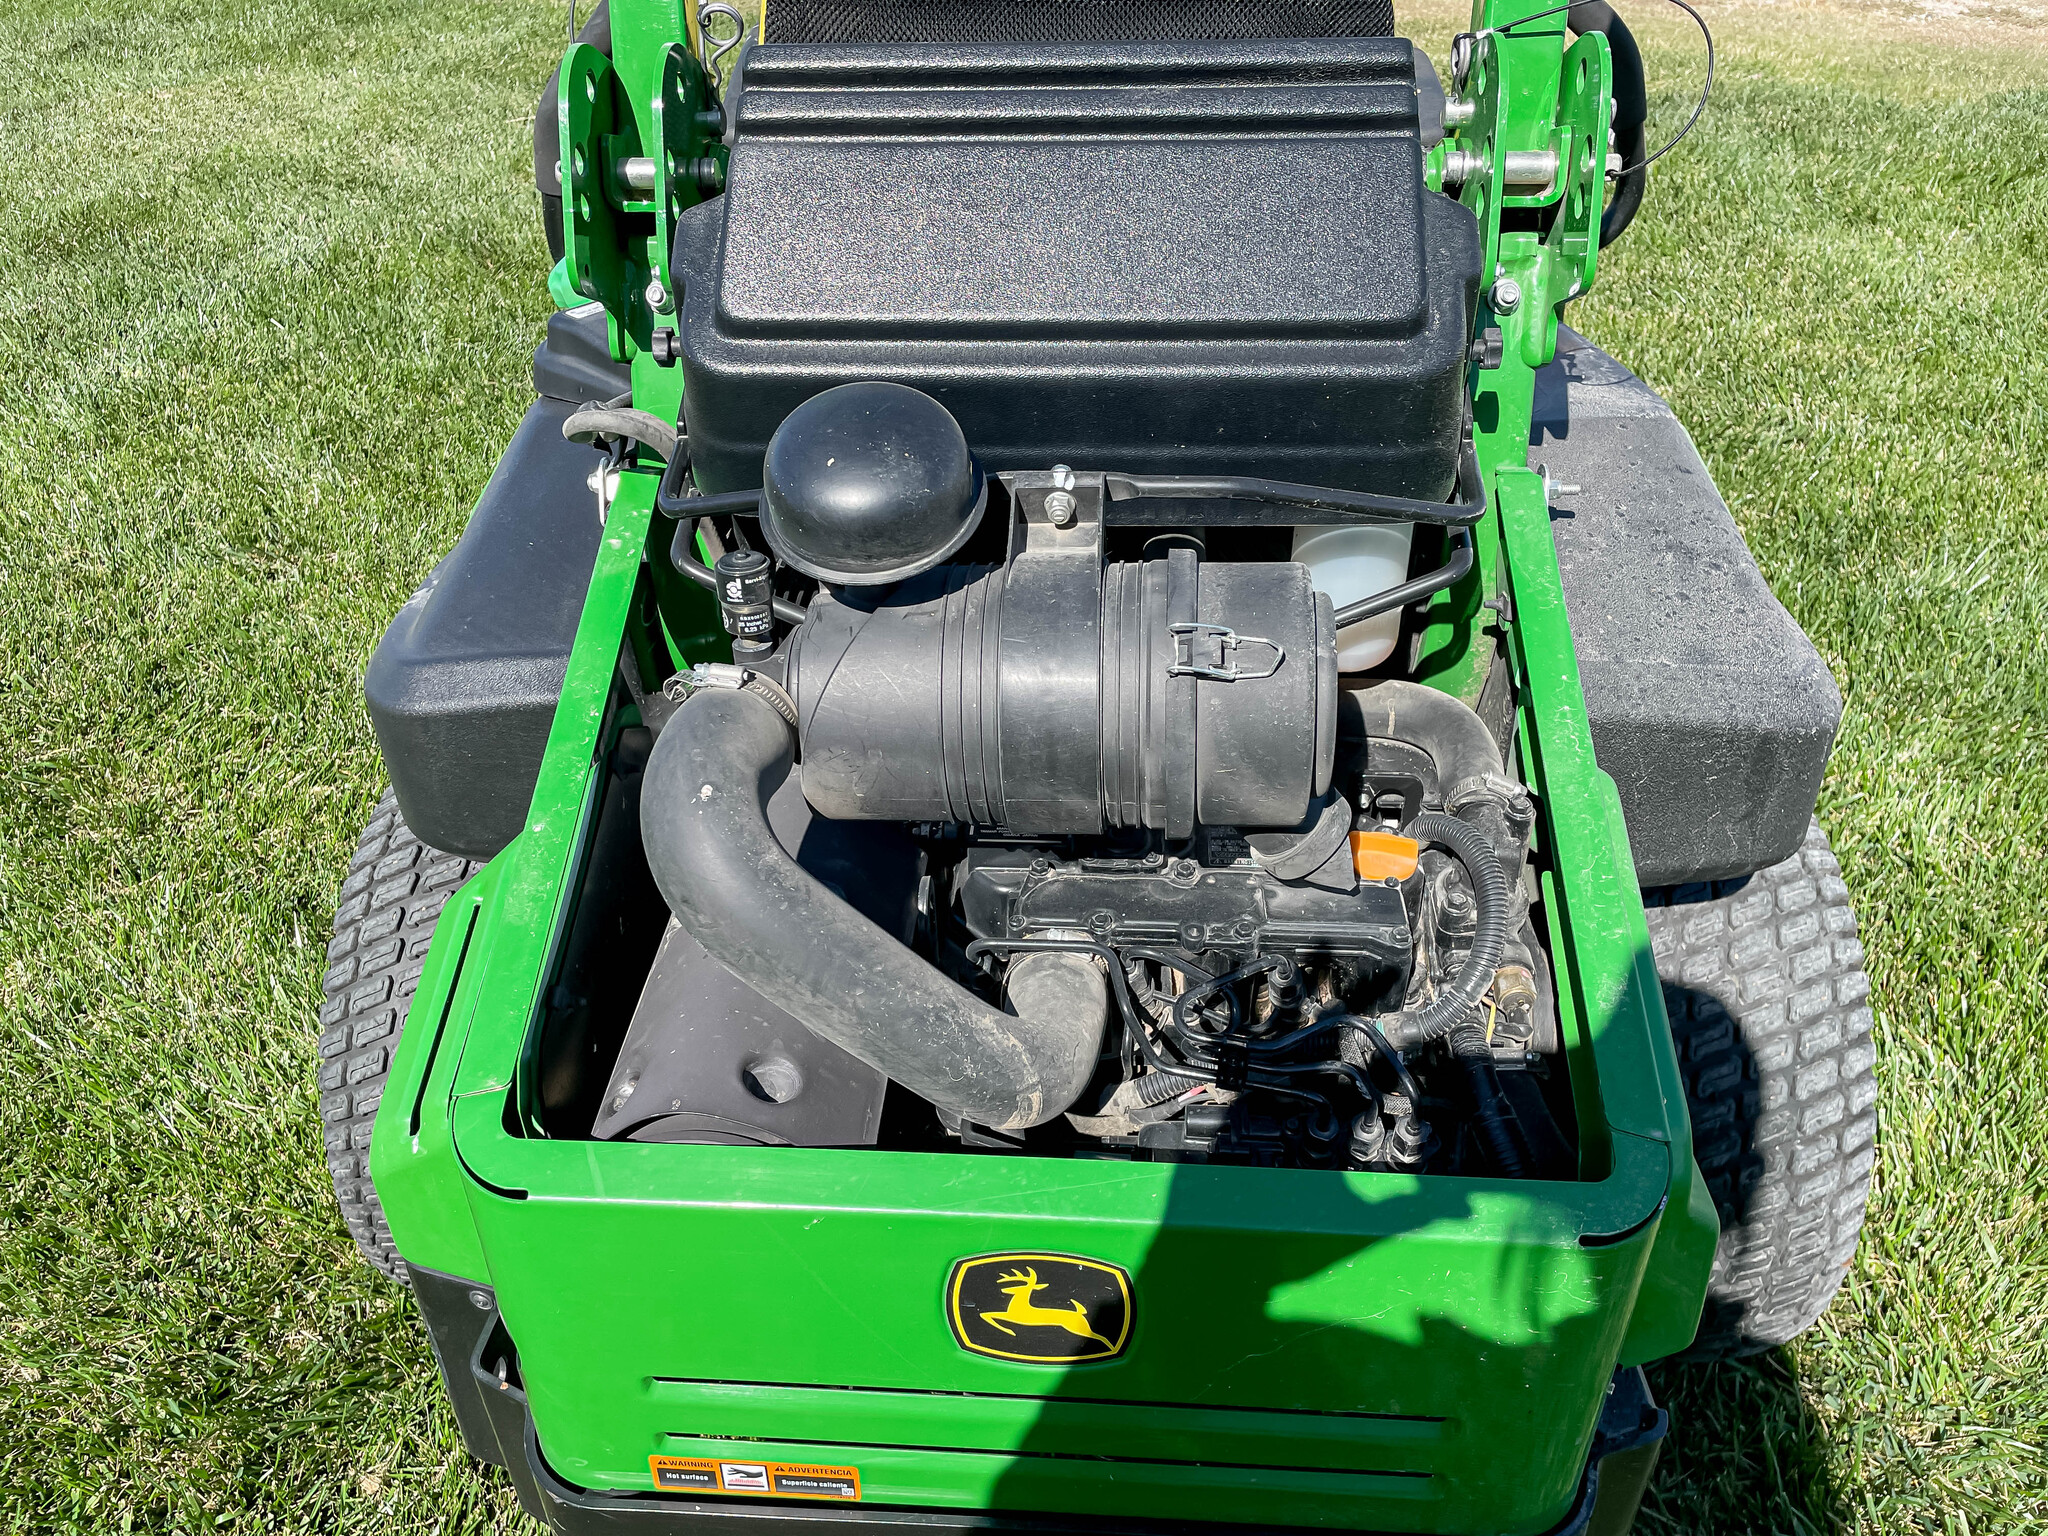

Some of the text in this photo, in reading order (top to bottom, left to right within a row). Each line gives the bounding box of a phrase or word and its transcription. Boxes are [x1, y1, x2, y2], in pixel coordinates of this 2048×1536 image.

[668, 1460, 714, 1468] WARNING
[788, 1466, 853, 1476] ADVERTENCIA
[781, 1479, 818, 1487] Superficie
